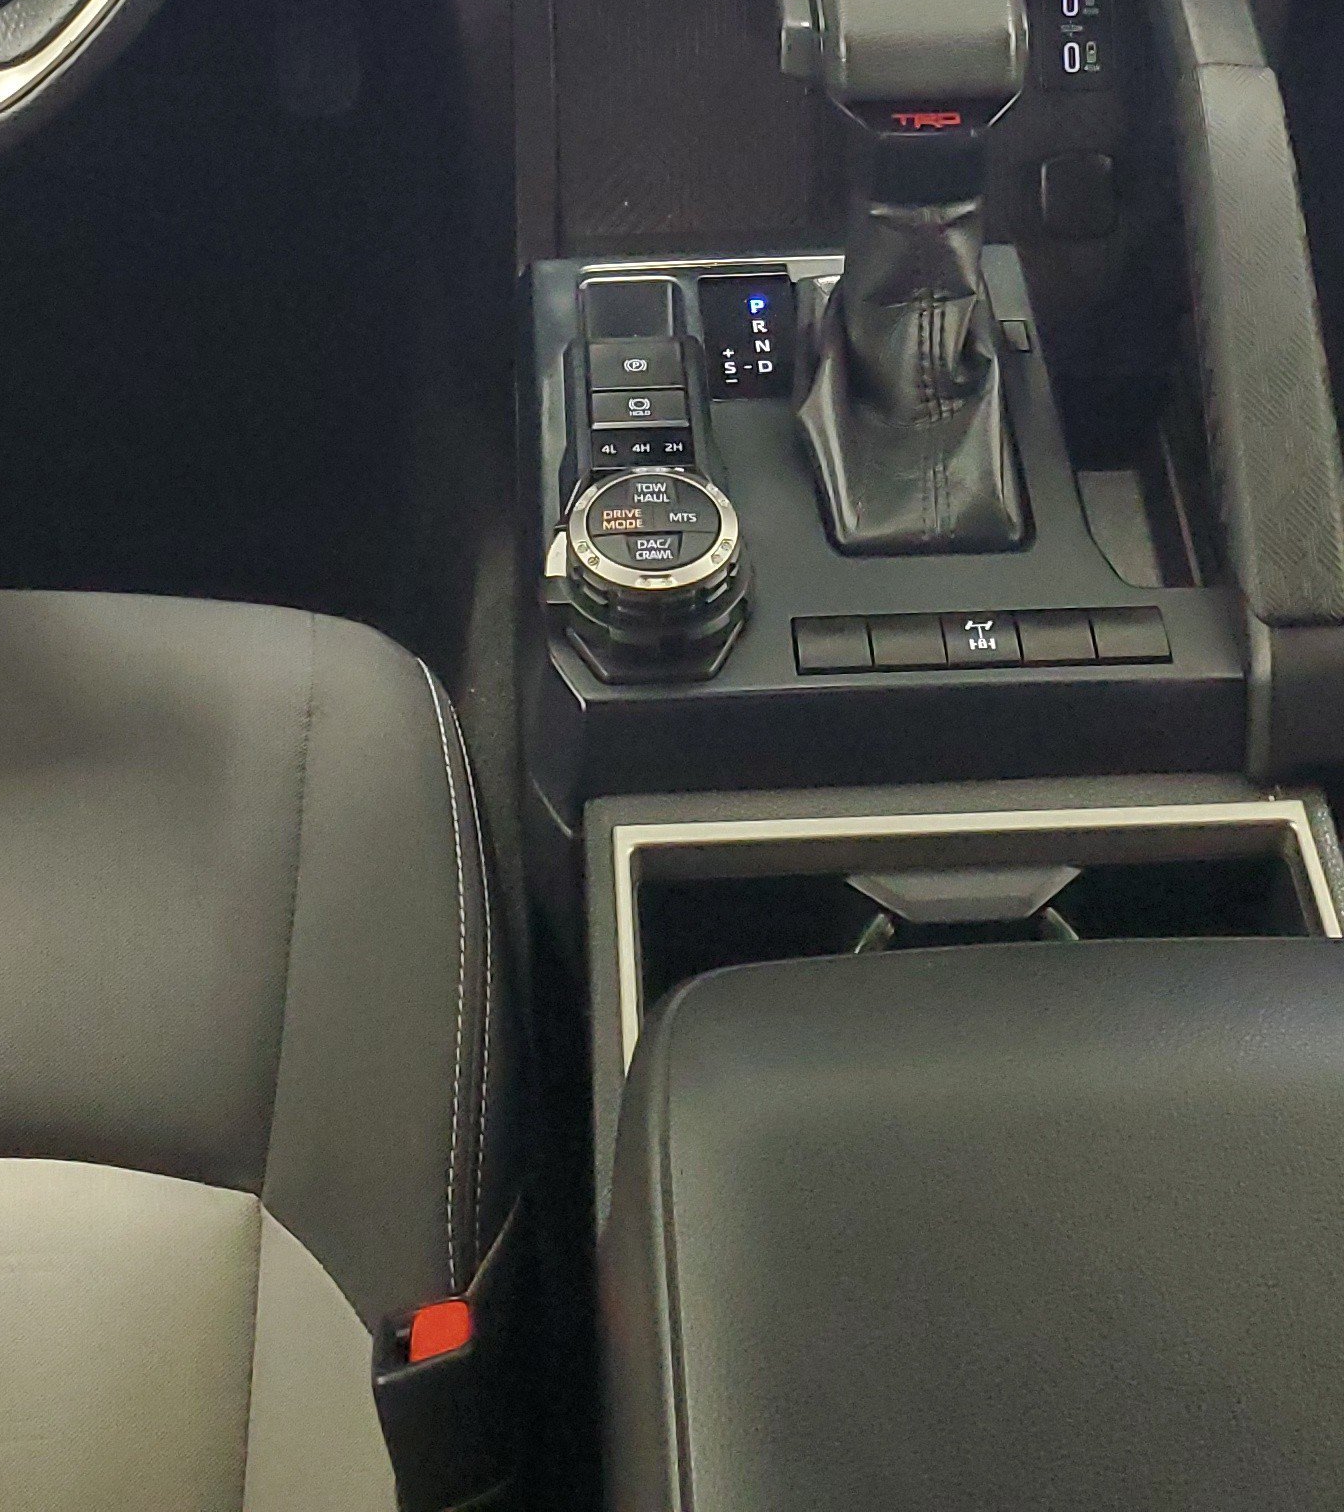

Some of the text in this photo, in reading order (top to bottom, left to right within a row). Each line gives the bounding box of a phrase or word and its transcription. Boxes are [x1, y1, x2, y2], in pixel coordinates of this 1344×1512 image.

[891, 112, 961, 129] TRD
[750, 299, 765, 314] P
[752, 320, 768, 333] R
[755, 339, 771, 353] N
[724, 360, 773, 374] S D
[601, 444, 617, 454] 4L
[632, 443, 651, 453] 4H
[664, 441, 683, 452] 2H
[636, 482, 667, 493] TOW
[634, 494, 670, 503] HAUL
[603, 509, 643, 519] DRIVE
[669, 512, 697, 523] MTS
[602, 519, 644, 530] MODE
[637, 538, 671, 550] DAC/
[636, 550, 674, 560] CRAWL
